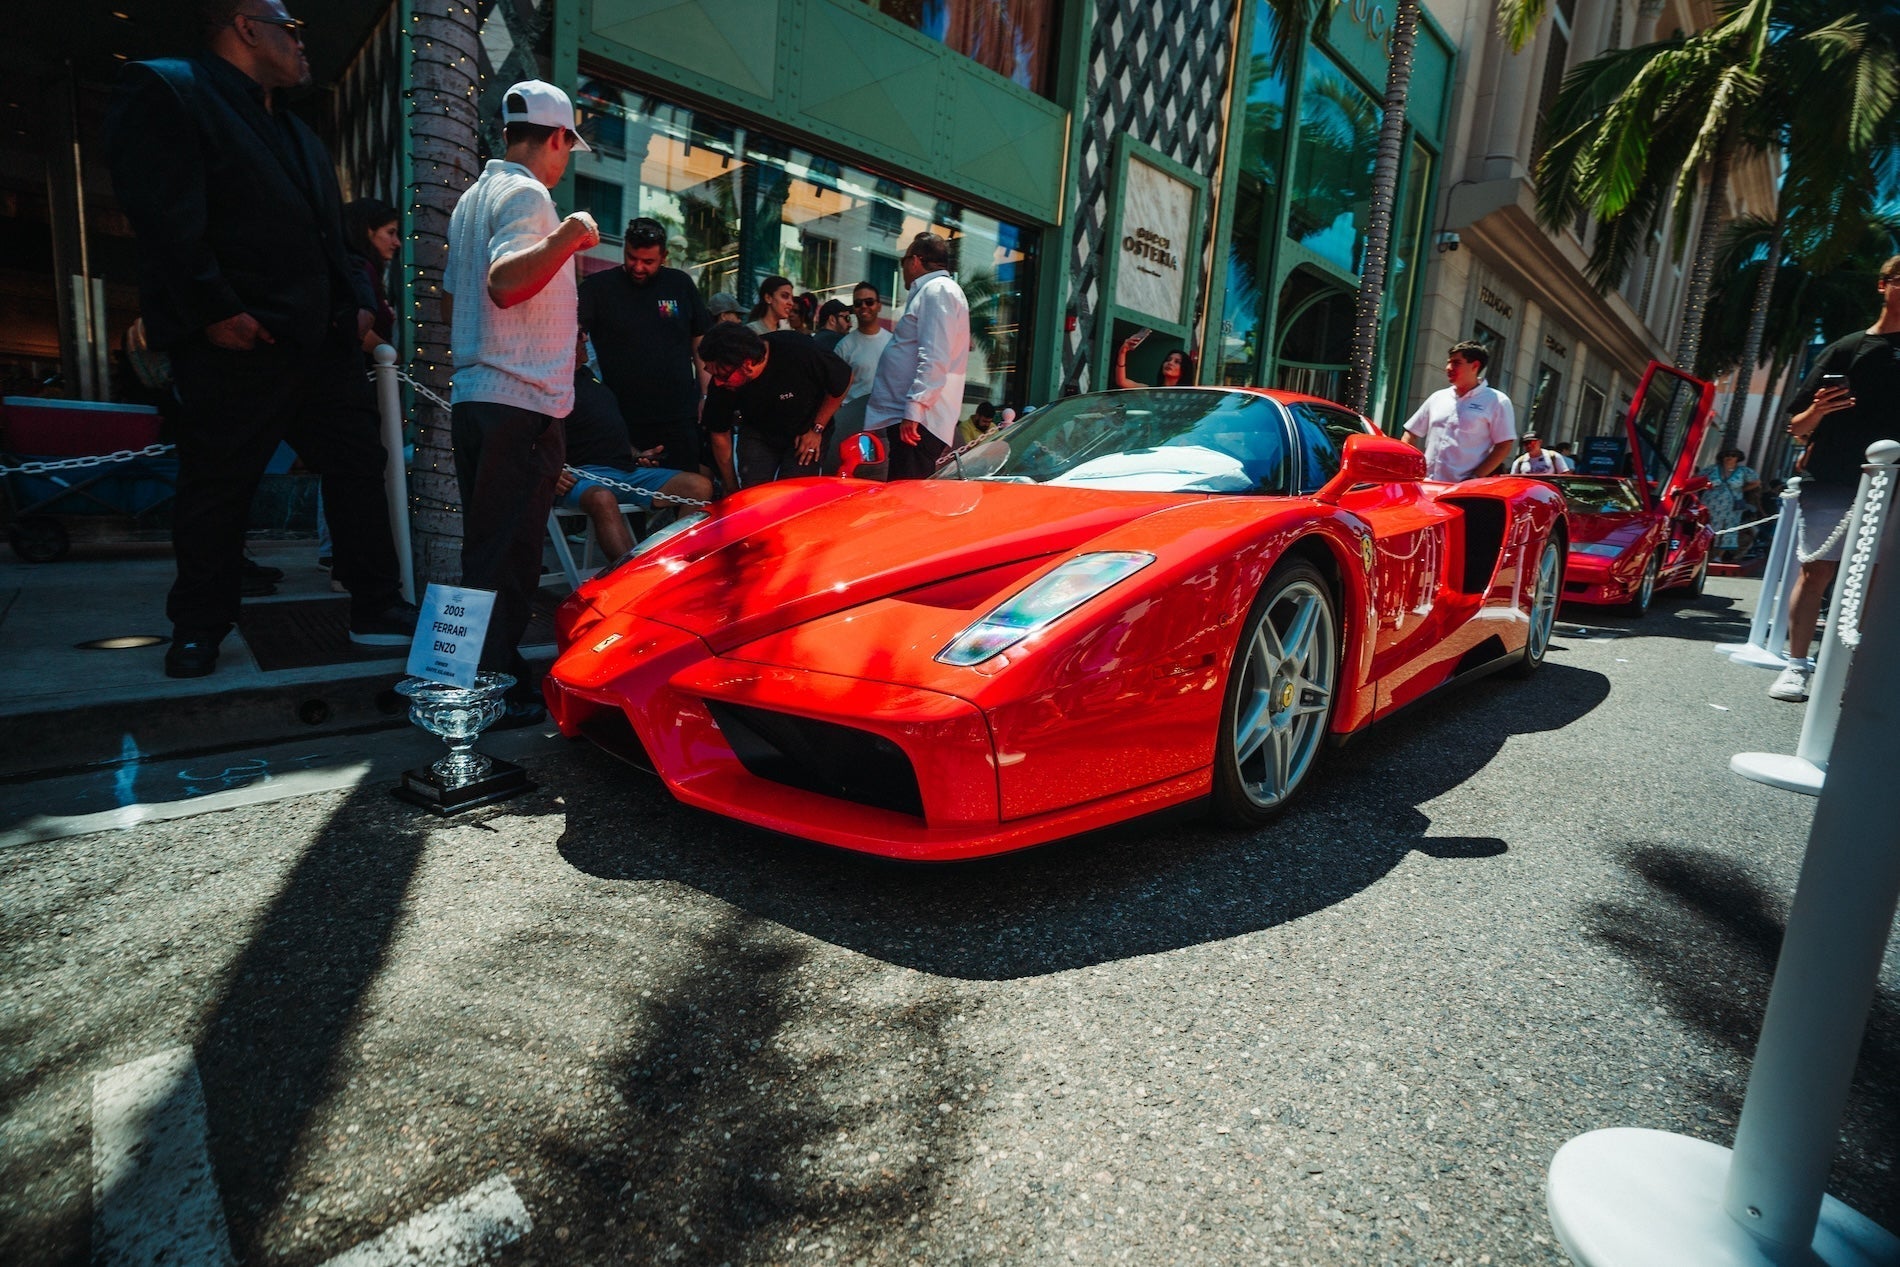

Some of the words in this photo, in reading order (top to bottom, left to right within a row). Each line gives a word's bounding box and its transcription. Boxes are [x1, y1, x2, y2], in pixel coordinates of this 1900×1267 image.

[1137, 227, 1170, 250] GUCCI
[1123, 236, 1177, 271] OSTERIA
[443, 604, 465, 617] 2003
[432, 621, 468, 637] FERRARI
[433, 640, 456, 654] ENZO
